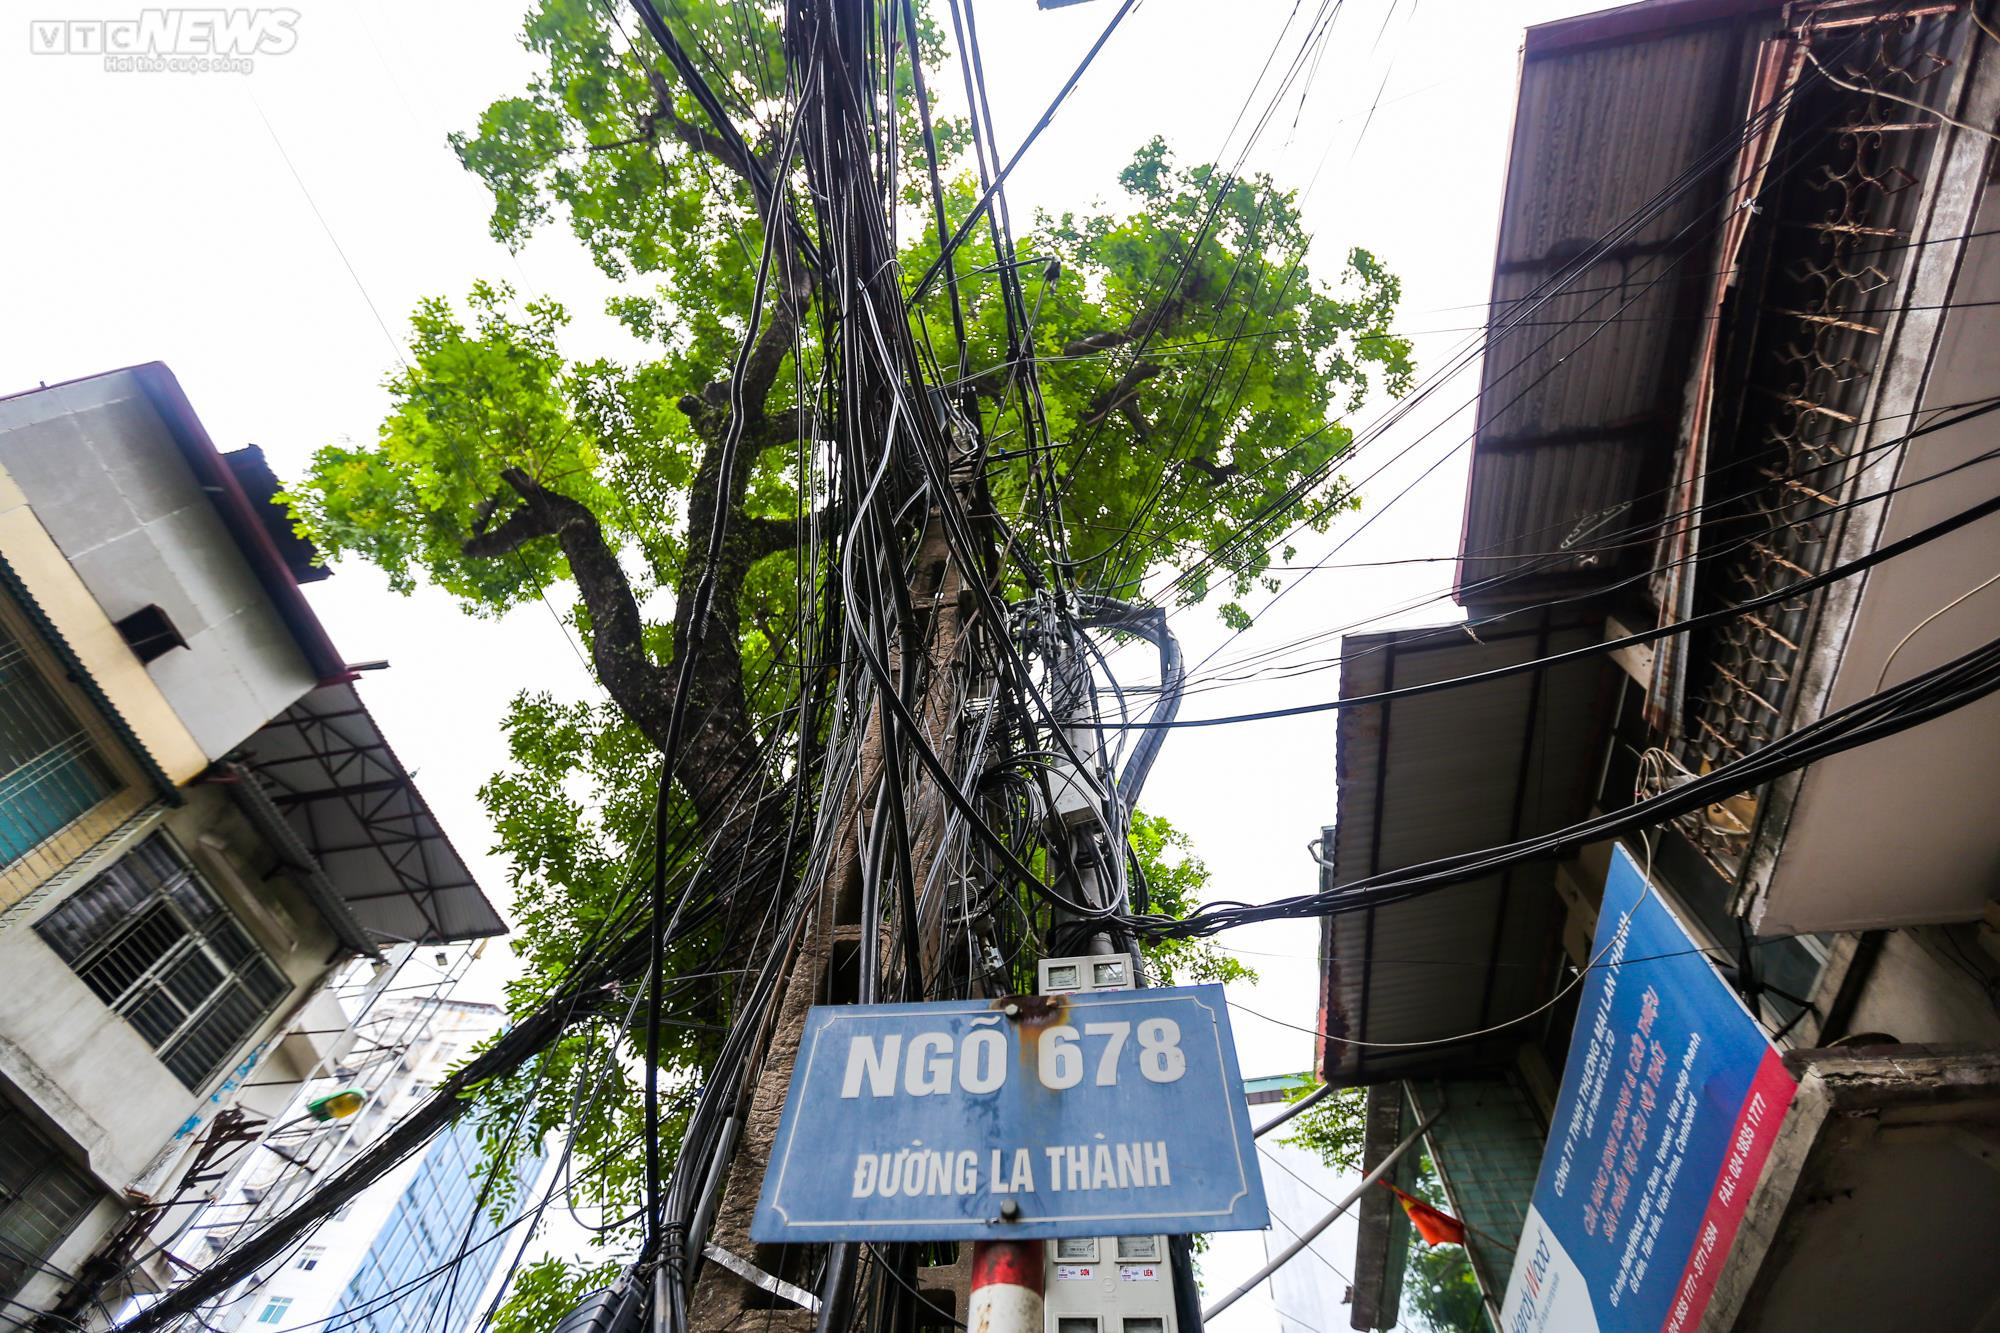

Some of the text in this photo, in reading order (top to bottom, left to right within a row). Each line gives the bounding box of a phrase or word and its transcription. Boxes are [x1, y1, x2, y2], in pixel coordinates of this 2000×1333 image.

[1600, 972, 1616, 1011] LAN
[841, 1015, 1187, 1099] NGÕ 678
[1682, 1031, 1701, 1071] thanh
[1568, 1098, 1585, 1141] TNHH
[1583, 1110, 1595, 1138] LAN
[1674, 1090, 1698, 1154] Cemboard
[1746, 1091, 1766, 1127] 1777
[1563, 1136, 1574, 1160] TY
[1735, 1122, 1755, 1158] 3835
[852, 1132, 1172, 1199] ĐƯỜNG LA THÀNH
[1554, 1155, 1570, 1197] CÔNG
[1728, 1151, 1744, 1179] 024
[1718, 1176, 1735, 1207] FAX:
[1702, 1220, 1718, 1253] 2584
[1693, 1245, 1708, 1276] 3771
[1683, 1273, 1697, 1302] 1777
